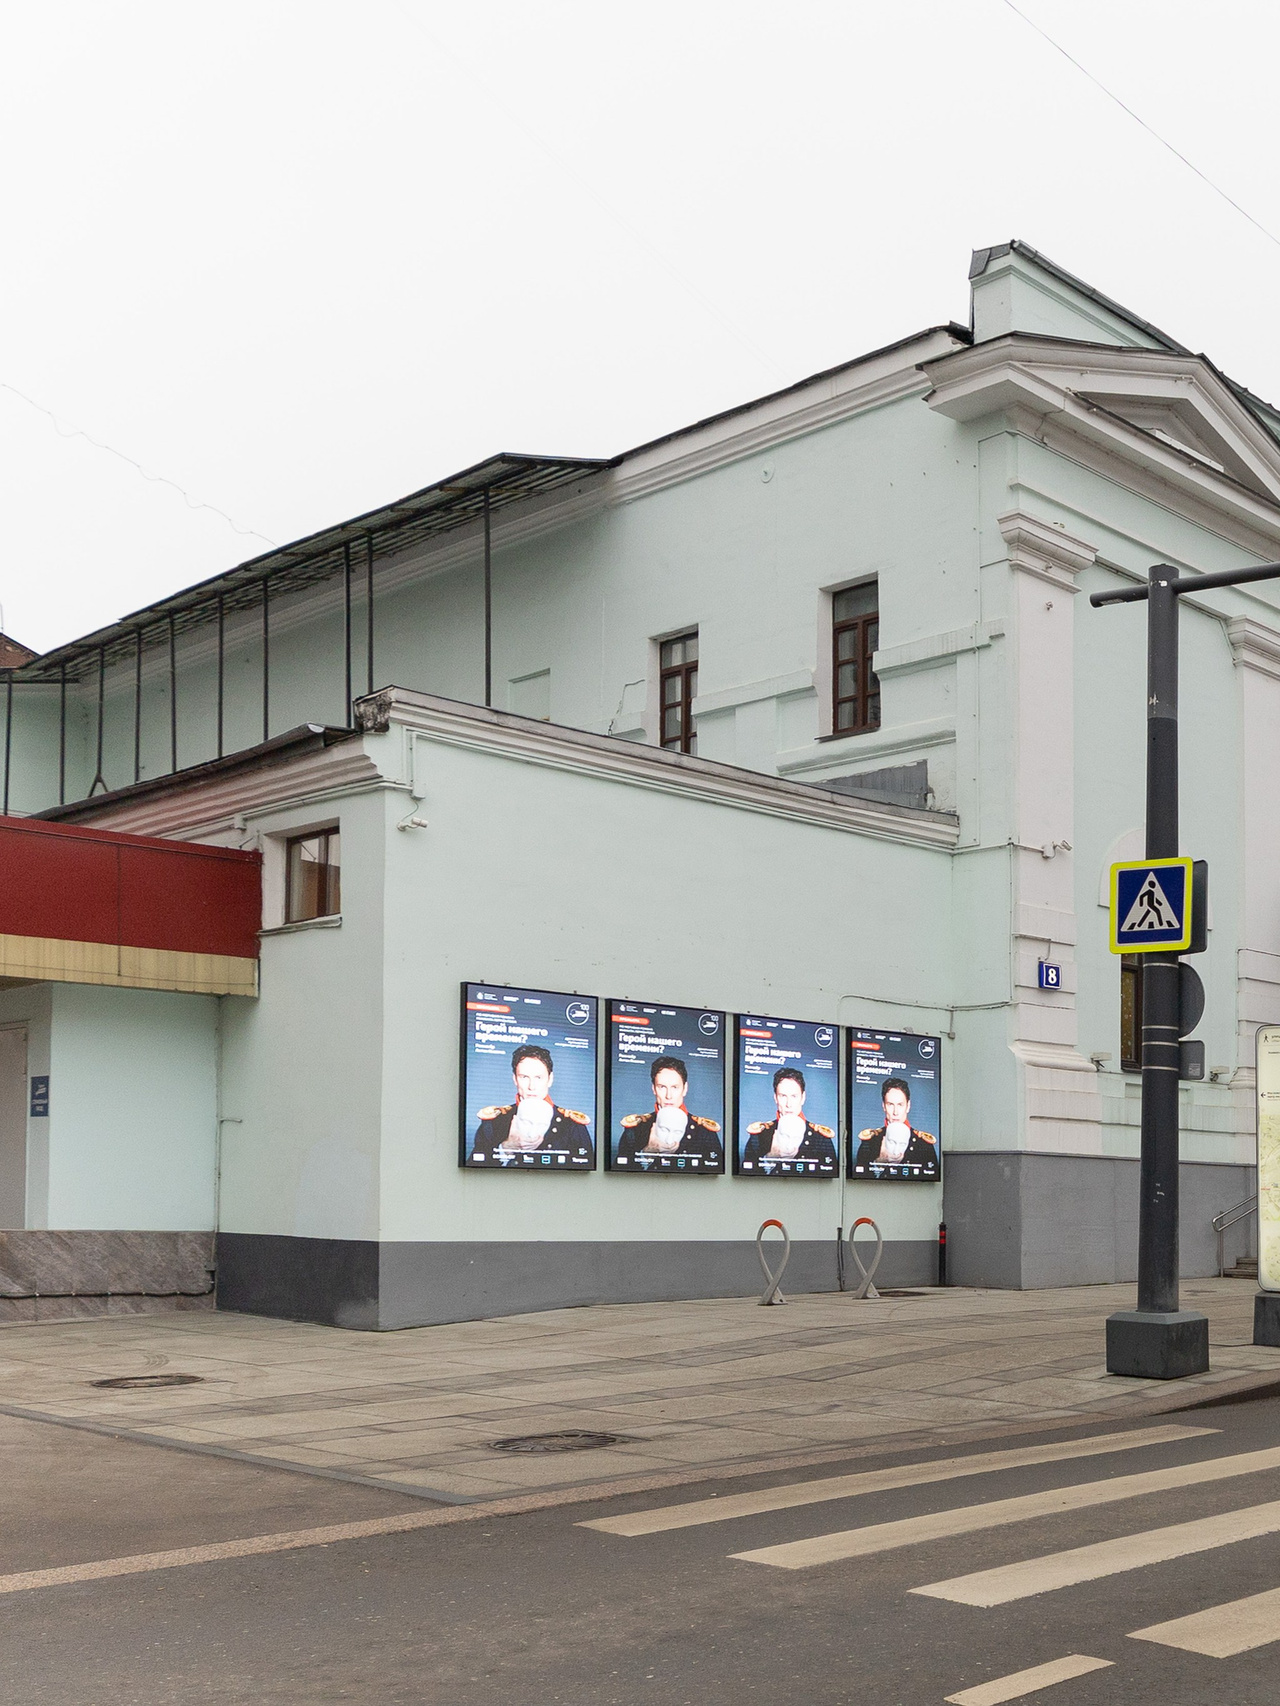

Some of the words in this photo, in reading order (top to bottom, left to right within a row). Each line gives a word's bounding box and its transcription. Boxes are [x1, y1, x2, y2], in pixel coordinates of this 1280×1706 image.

[1048, 968, 1057, 984] 8
[476, 1021, 507, 1034] Герой
[508, 1026, 548, 1036] нашего
[475, 1032, 528, 1044] времени?
[618, 1032, 646, 1044] Герой
[648, 1036, 682, 1047] нашего
[618, 1043, 665, 1054] времени?
[745, 1045, 770, 1056] Герой
[770, 1049, 802, 1059] нашего
[745, 1055, 786, 1065] времени?
[856, 1057, 878, 1067] Герой
[879, 1060, 906, 1069] нашего
[856, 1066, 893, 1075] времени?
